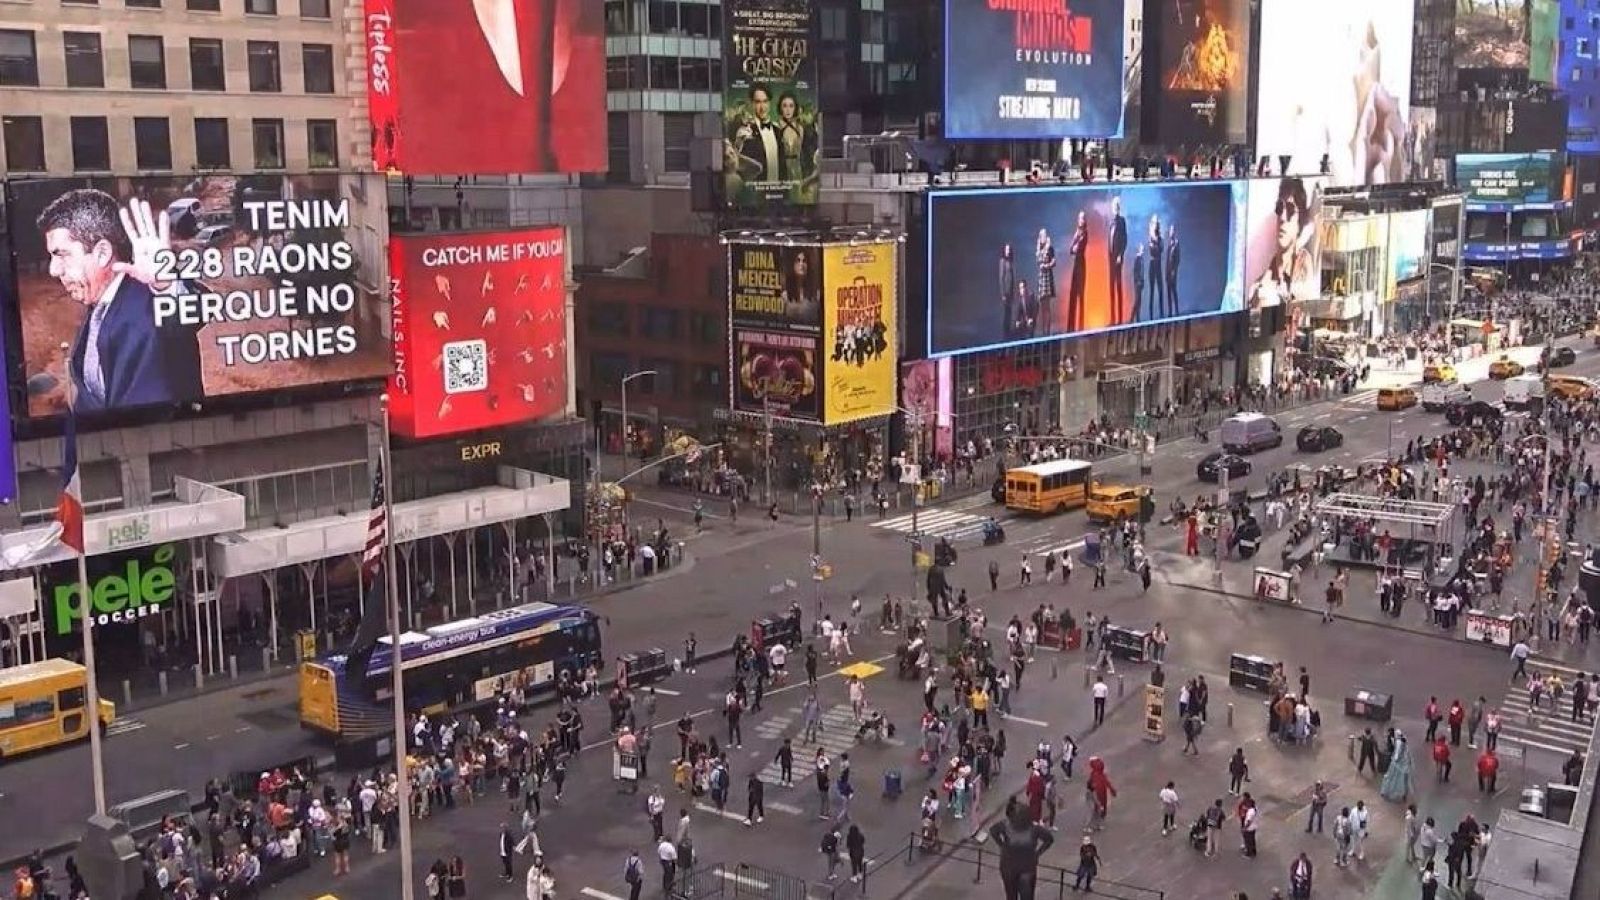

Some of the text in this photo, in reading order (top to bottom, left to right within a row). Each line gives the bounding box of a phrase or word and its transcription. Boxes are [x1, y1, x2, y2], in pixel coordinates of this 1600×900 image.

[733, 34, 807, 58] THE GREAT
[1016, 49, 1092, 65] EVOLUTION
[743, 57, 801, 78] GATSBY
[999, 95, 1051, 119] STREAMING
[1053, 97, 1073, 119] MAY
[242, 199, 350, 231] TENIM
[154, 241, 352, 281] 228 RAONS
[422, 247, 482, 267] CATCH
[486, 244, 510, 262] ME
[513, 244, 525, 260] IF
[526, 240, 550, 258] YOU
[745, 251, 775, 269] IDINA
[738, 269, 782, 290] MENZEL
[153, 280, 355, 328] PERQUÈ NO
[736, 294, 785, 314] REDWOOD
[837, 284, 883, 308] OPERATION
[216, 325, 357, 366] TORNES
[461, 443, 501, 461] EXPR
[108, 514, 150, 547] pelé
[55, 544, 176, 635] pelé
[88, 603, 160, 628] SOCCER
[422, 626, 496, 651] clean-energy bus
